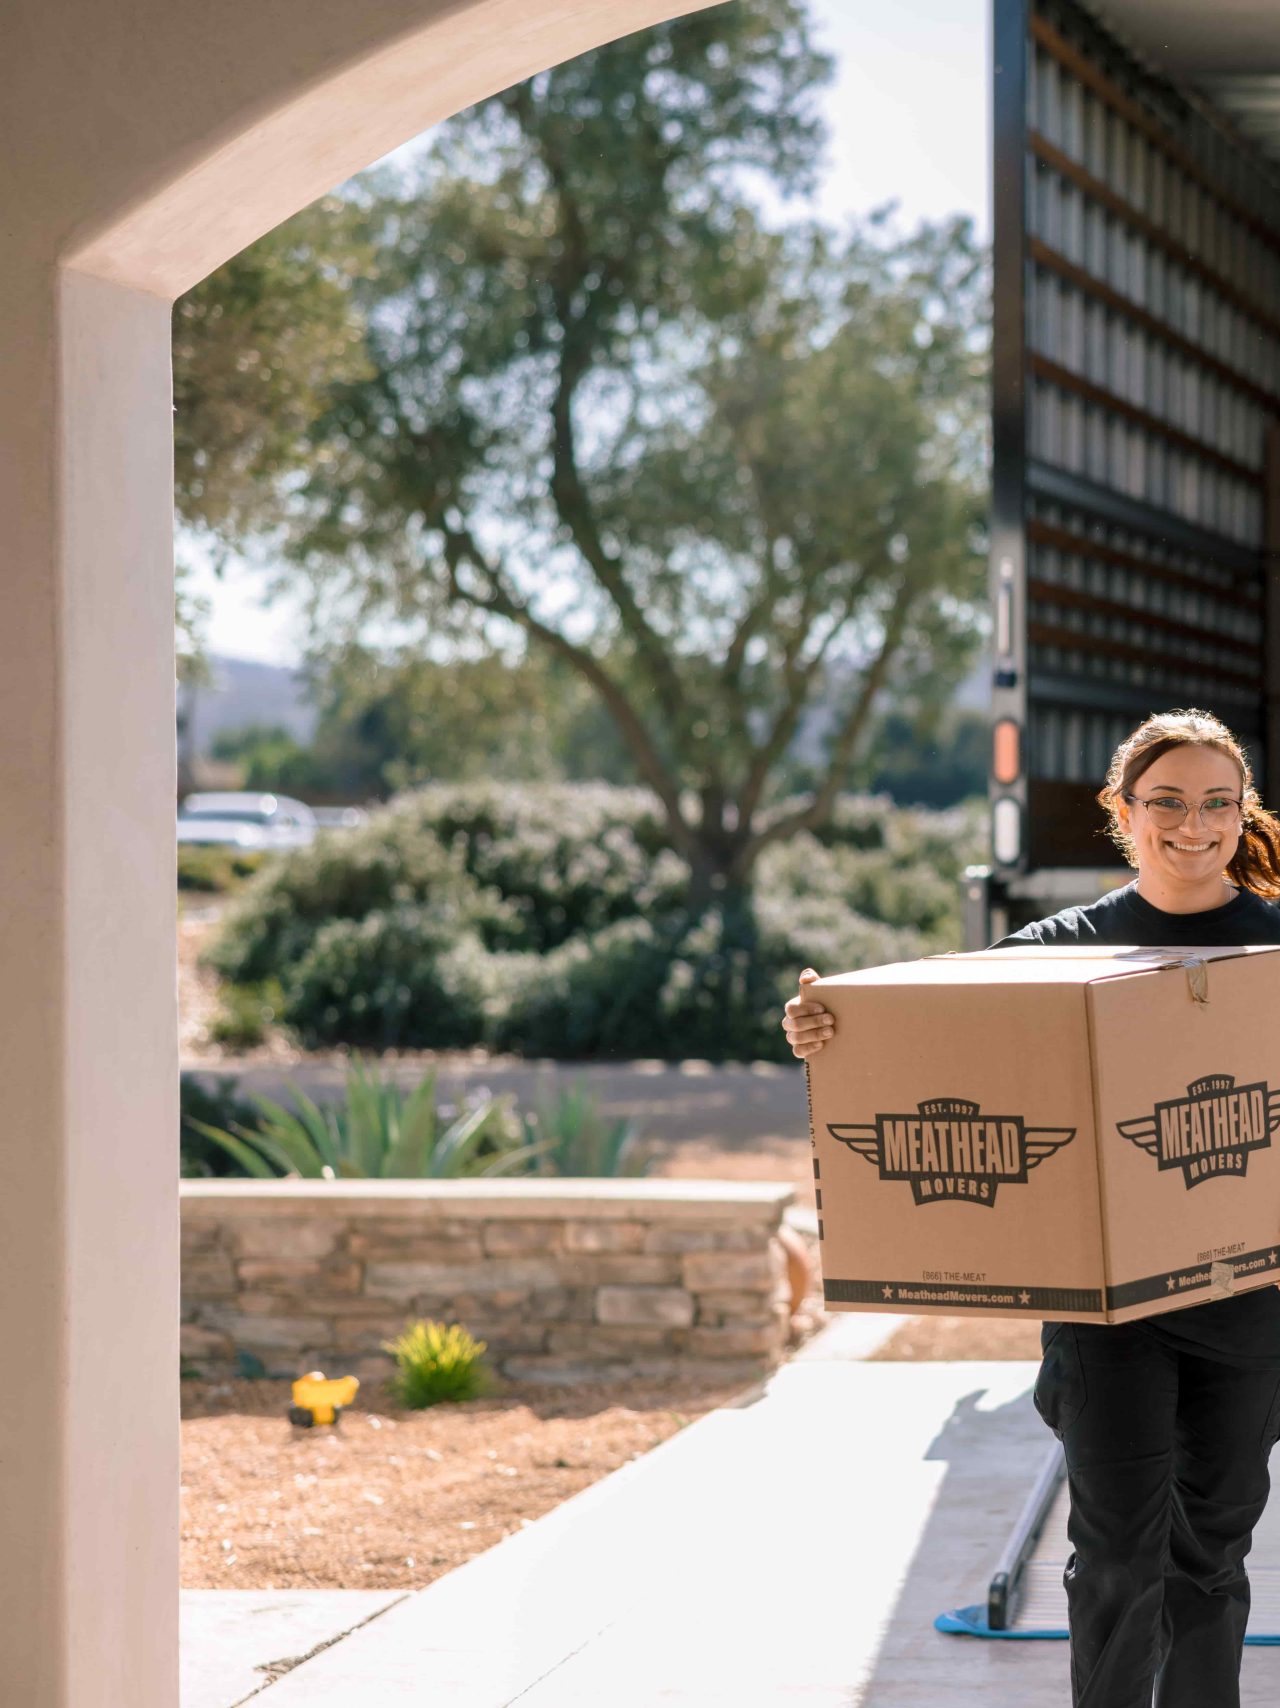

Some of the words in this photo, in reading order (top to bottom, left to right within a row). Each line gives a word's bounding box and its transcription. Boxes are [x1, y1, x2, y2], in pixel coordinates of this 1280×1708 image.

[1192, 1082, 1210, 1096] EST.
[1211, 1080, 1230, 1090] 1997
[924, 1103, 947, 1115] EST.
[950, 1103, 974, 1115] 1997
[1160, 1089, 1265, 1161] MEATHEAD
[883, 1120, 1021, 1175] MEATHEAD
[1190, 1153, 1242, 1179] MOVERS
[920, 1177, 989, 1198] MOVERS
[1213, 1242, 1245, 1258] THE-MEAT
[943, 1271, 986, 1282] THE-MEAT
[1178, 1258, 1266, 1287] Meatheers.com
[898, 1289, 1014, 1303] MeatheadMovers.com
